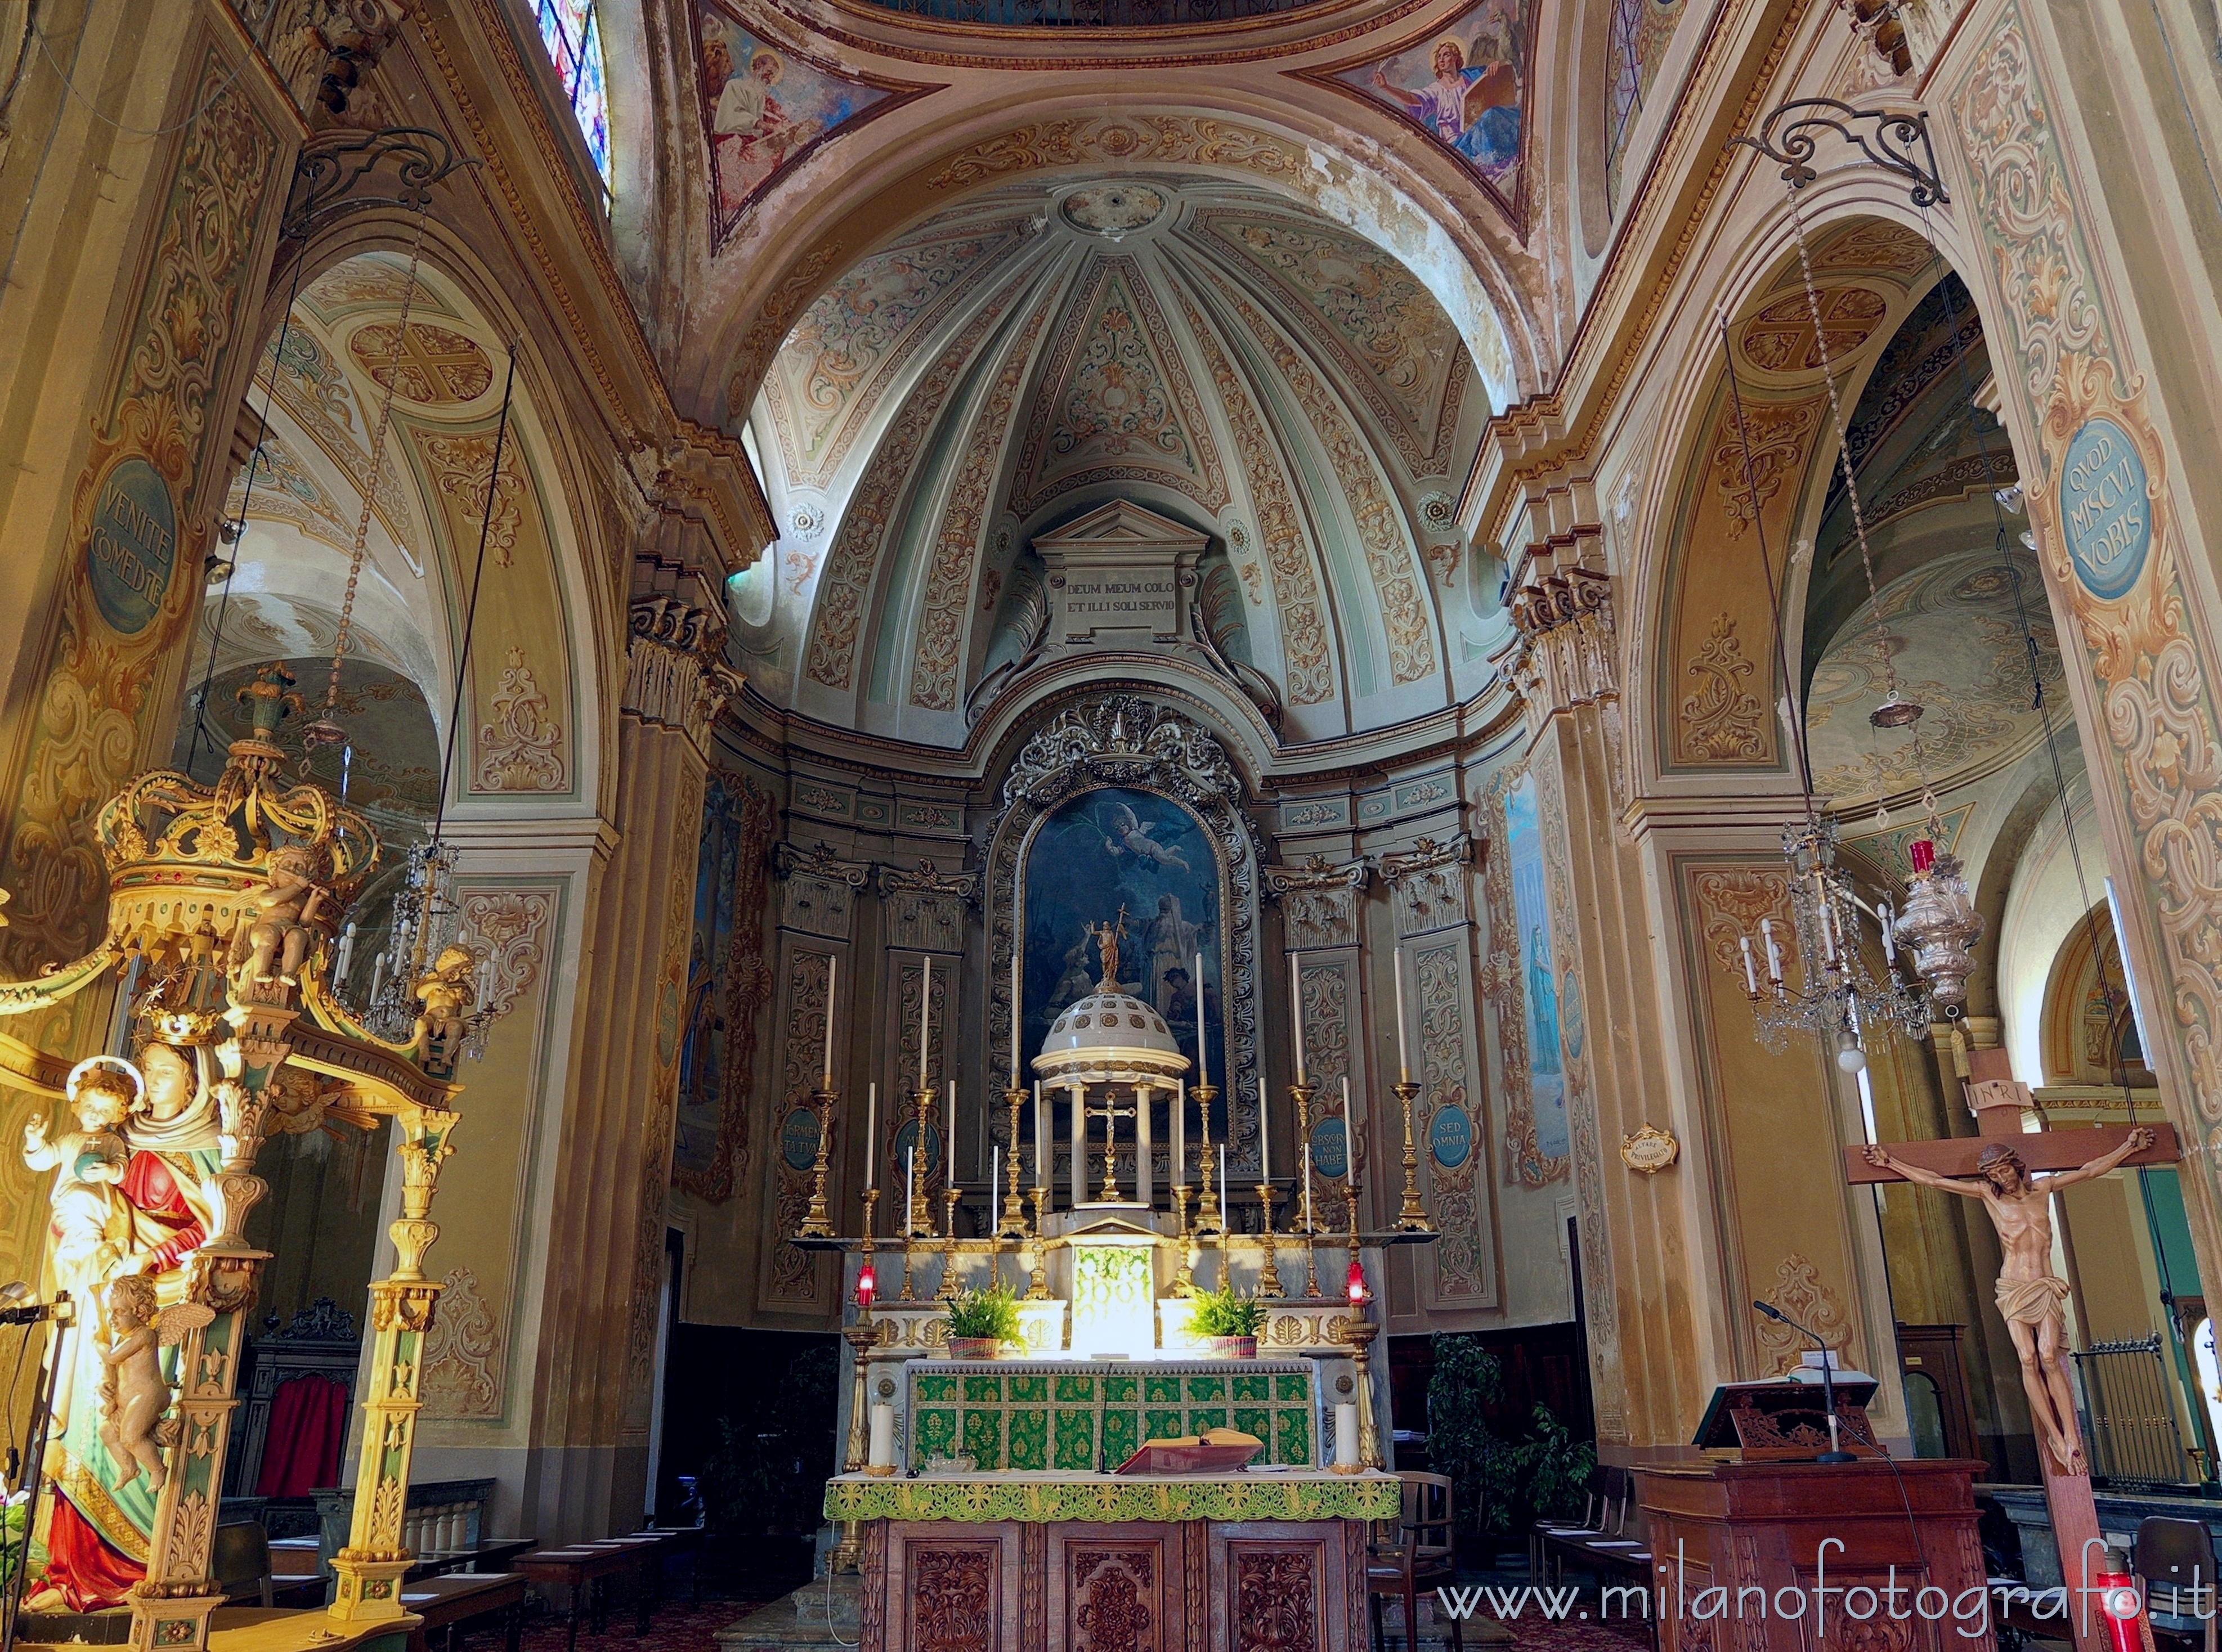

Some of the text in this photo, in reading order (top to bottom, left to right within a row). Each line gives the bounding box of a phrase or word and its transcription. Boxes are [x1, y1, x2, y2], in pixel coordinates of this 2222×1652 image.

[105, 481, 172, 564] VENITE
[2079, 500, 2143, 577] VOBIS
[1067, 582, 1175, 594] DEUM MEUM COLO
[1067, 600, 1175, 612] ET ILLI SOLI SERVIO
[1973, 1085, 2022, 1105] INRI
[1440, 1122, 1461, 1133] SED
[1432, 1134, 1466, 1147] OMNIA
[1636, 1142, 1657, 1150] ALTARE
